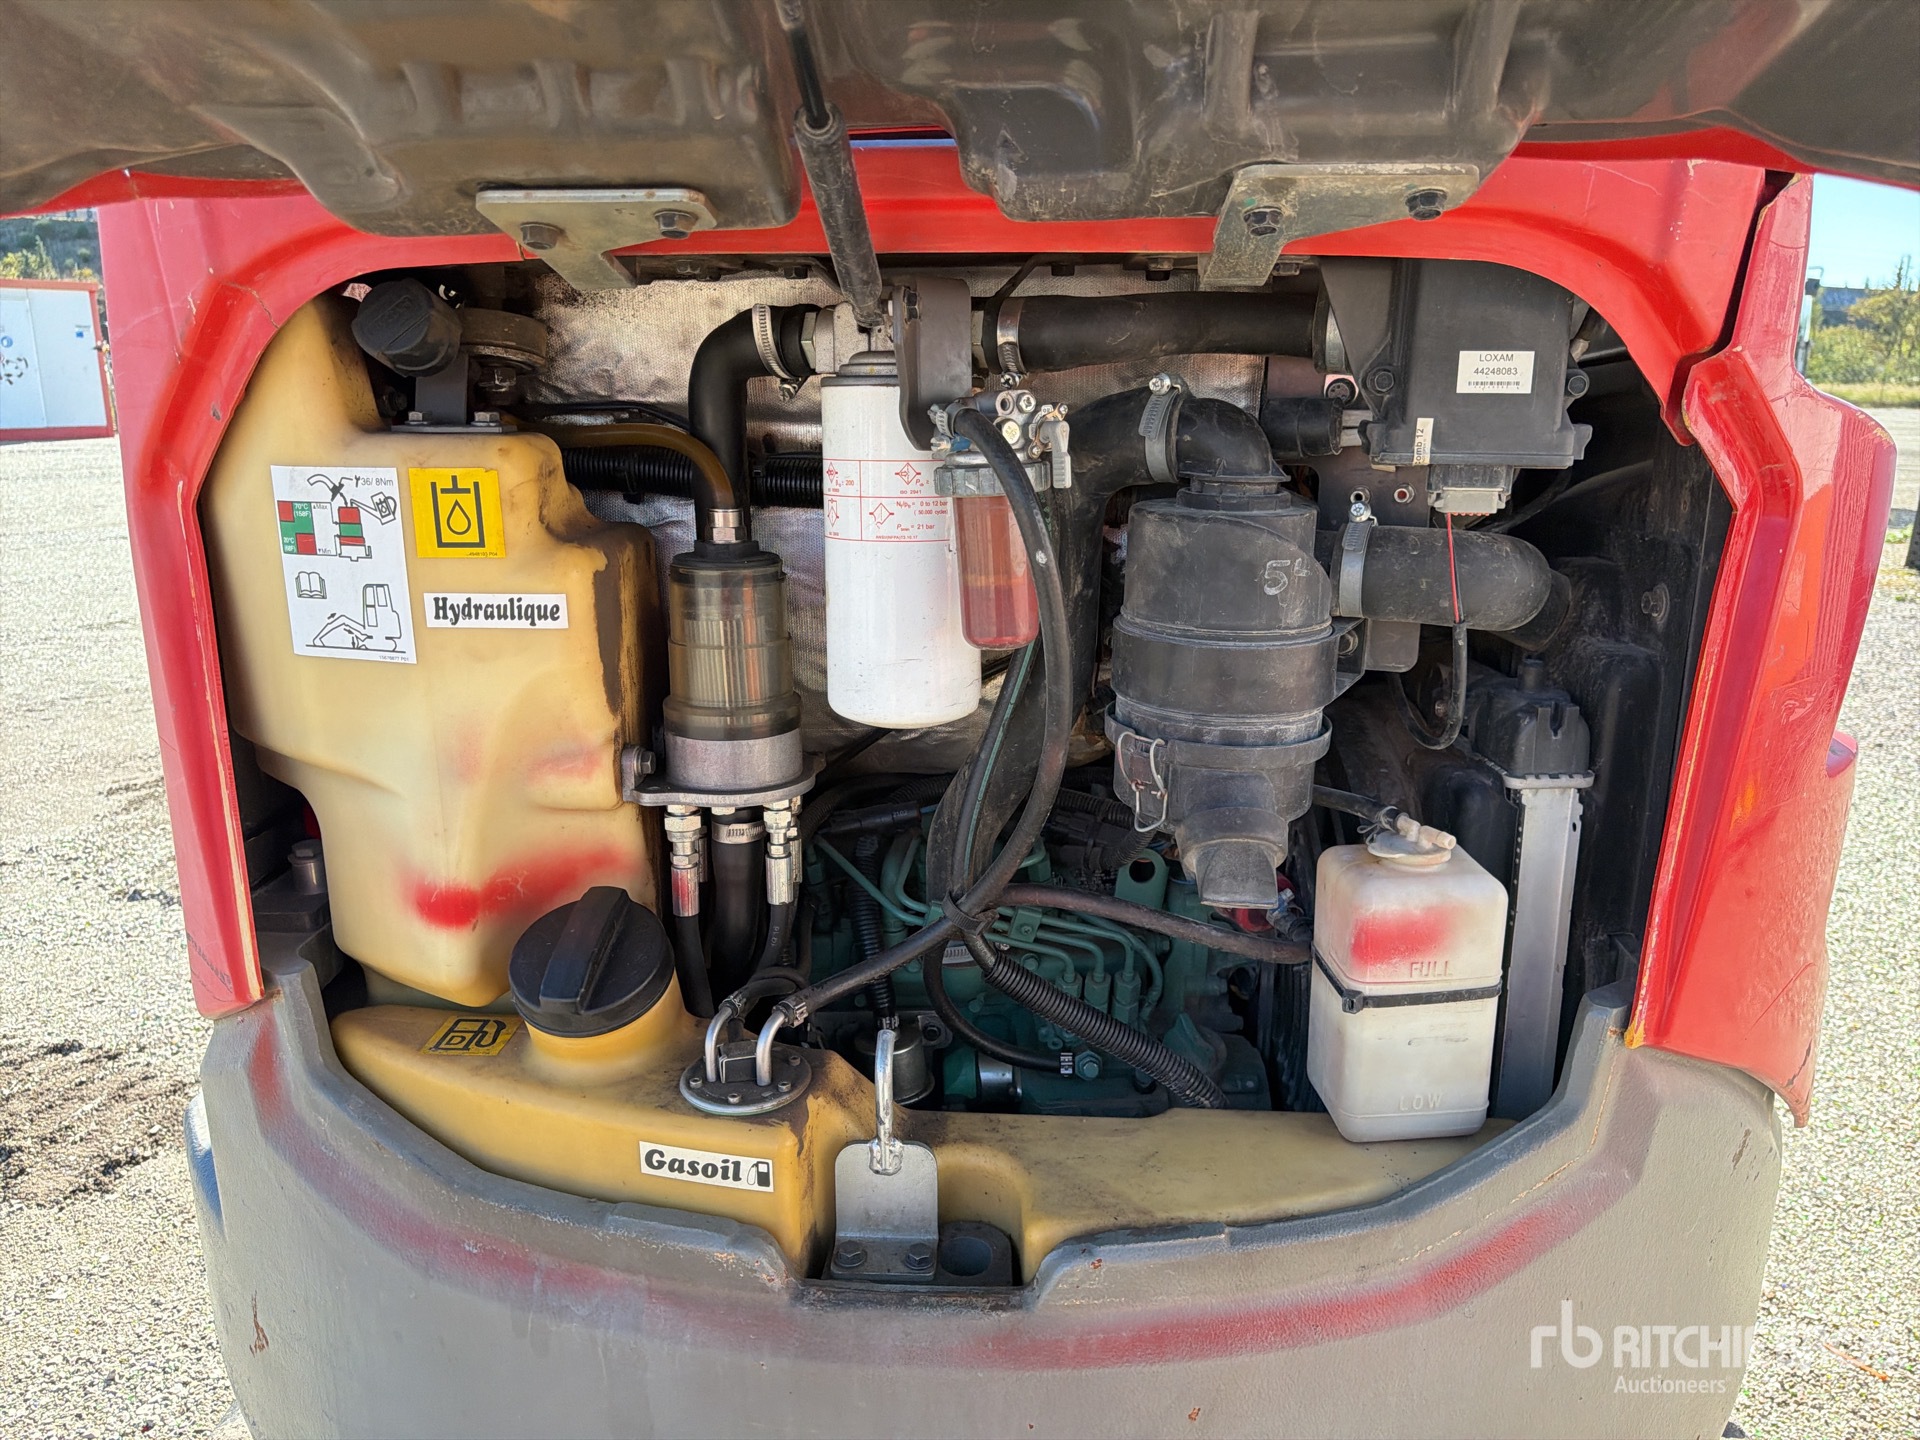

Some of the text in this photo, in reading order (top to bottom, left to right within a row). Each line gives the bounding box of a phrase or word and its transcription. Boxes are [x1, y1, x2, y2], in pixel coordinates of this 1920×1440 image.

[1479, 353, 1514, 362] LOXAM
[1473, 367, 1518, 376] 44248083
[1416, 428, 1425, 438] 12
[1414, 441, 1423, 465] omb
[375, 477, 394, 487] 8Nm
[432, 596, 561, 627] Hydraulique
[1409, 960, 1453, 978] FULL
[1399, 1093, 1443, 1111] LOW
[644, 1149, 742, 1182] Gasoil
